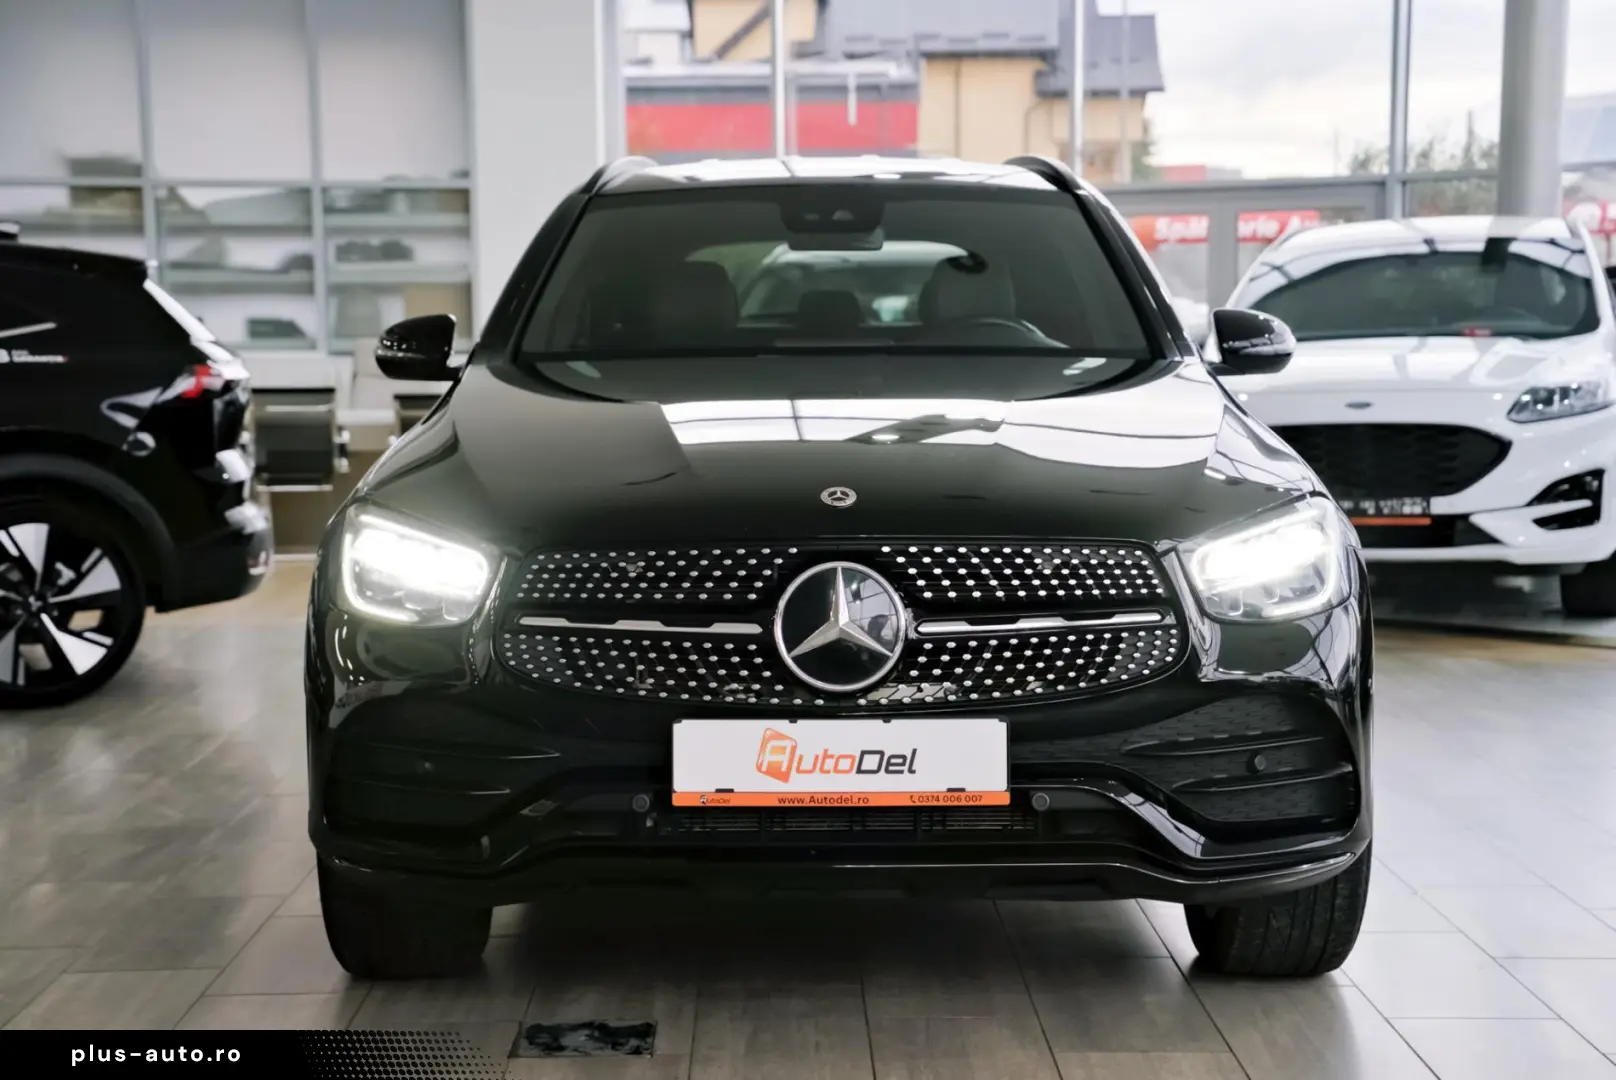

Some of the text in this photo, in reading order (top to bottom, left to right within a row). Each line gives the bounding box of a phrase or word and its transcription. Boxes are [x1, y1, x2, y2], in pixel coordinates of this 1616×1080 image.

[759, 736, 918, 776] AutoDel
[777, 795, 870, 805] www.Autodel.ro
[917, 795, 940, 803] 0374
[942, 795, 962, 803] 006
[964, 794, 983, 803] 007
